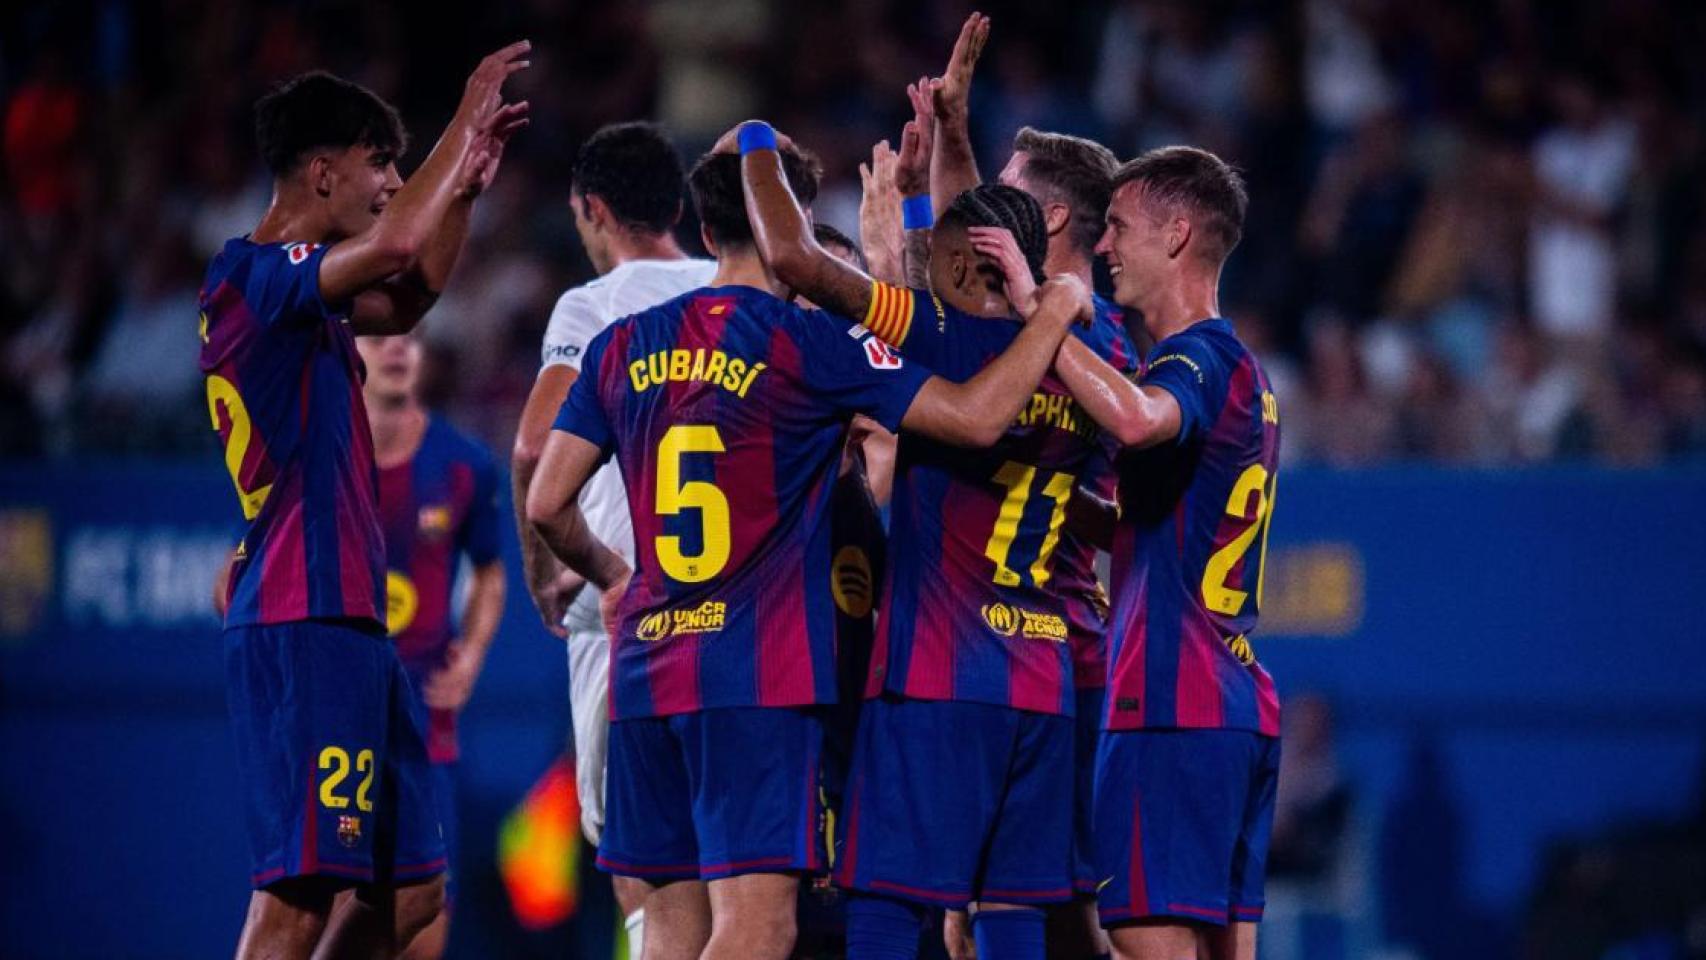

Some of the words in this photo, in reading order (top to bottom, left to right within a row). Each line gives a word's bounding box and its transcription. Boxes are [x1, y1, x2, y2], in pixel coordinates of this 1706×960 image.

[628, 348, 767, 398] CUBARSÍ
[655, 425, 732, 583] 5
[985, 460, 1076, 588] 11
[1202, 463, 1277, 616] 2
[318, 746, 374, 812] 22
